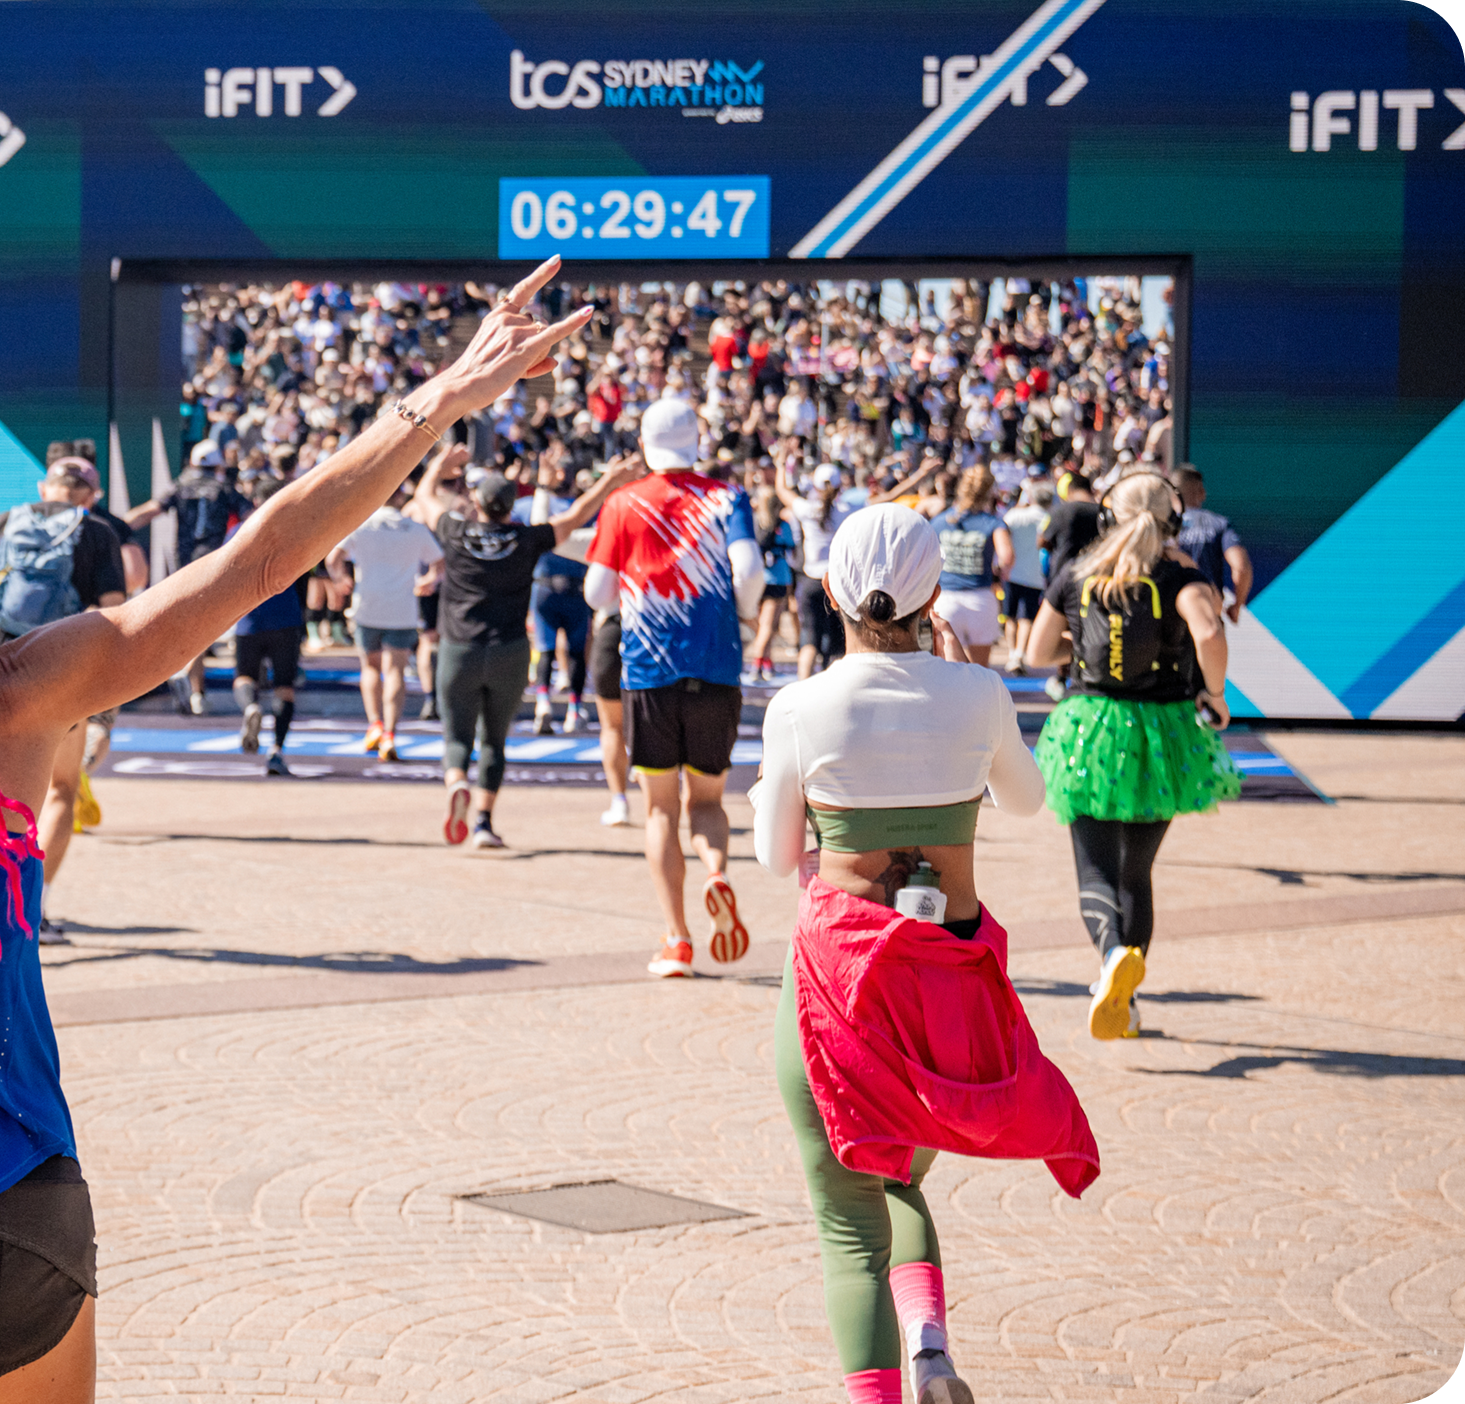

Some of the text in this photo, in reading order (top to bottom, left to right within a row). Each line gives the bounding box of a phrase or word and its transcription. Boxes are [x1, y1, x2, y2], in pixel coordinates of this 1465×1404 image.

[204, 66, 314, 118] iFIT
[510, 49, 709, 110] tcs SYDNEY
[604, 82, 764, 107] MARATHON
[1289, 88, 1435, 152] iFIT
[510, 189, 757, 240] 06:29:47
[1108, 613, 1123, 682] RUNLY
